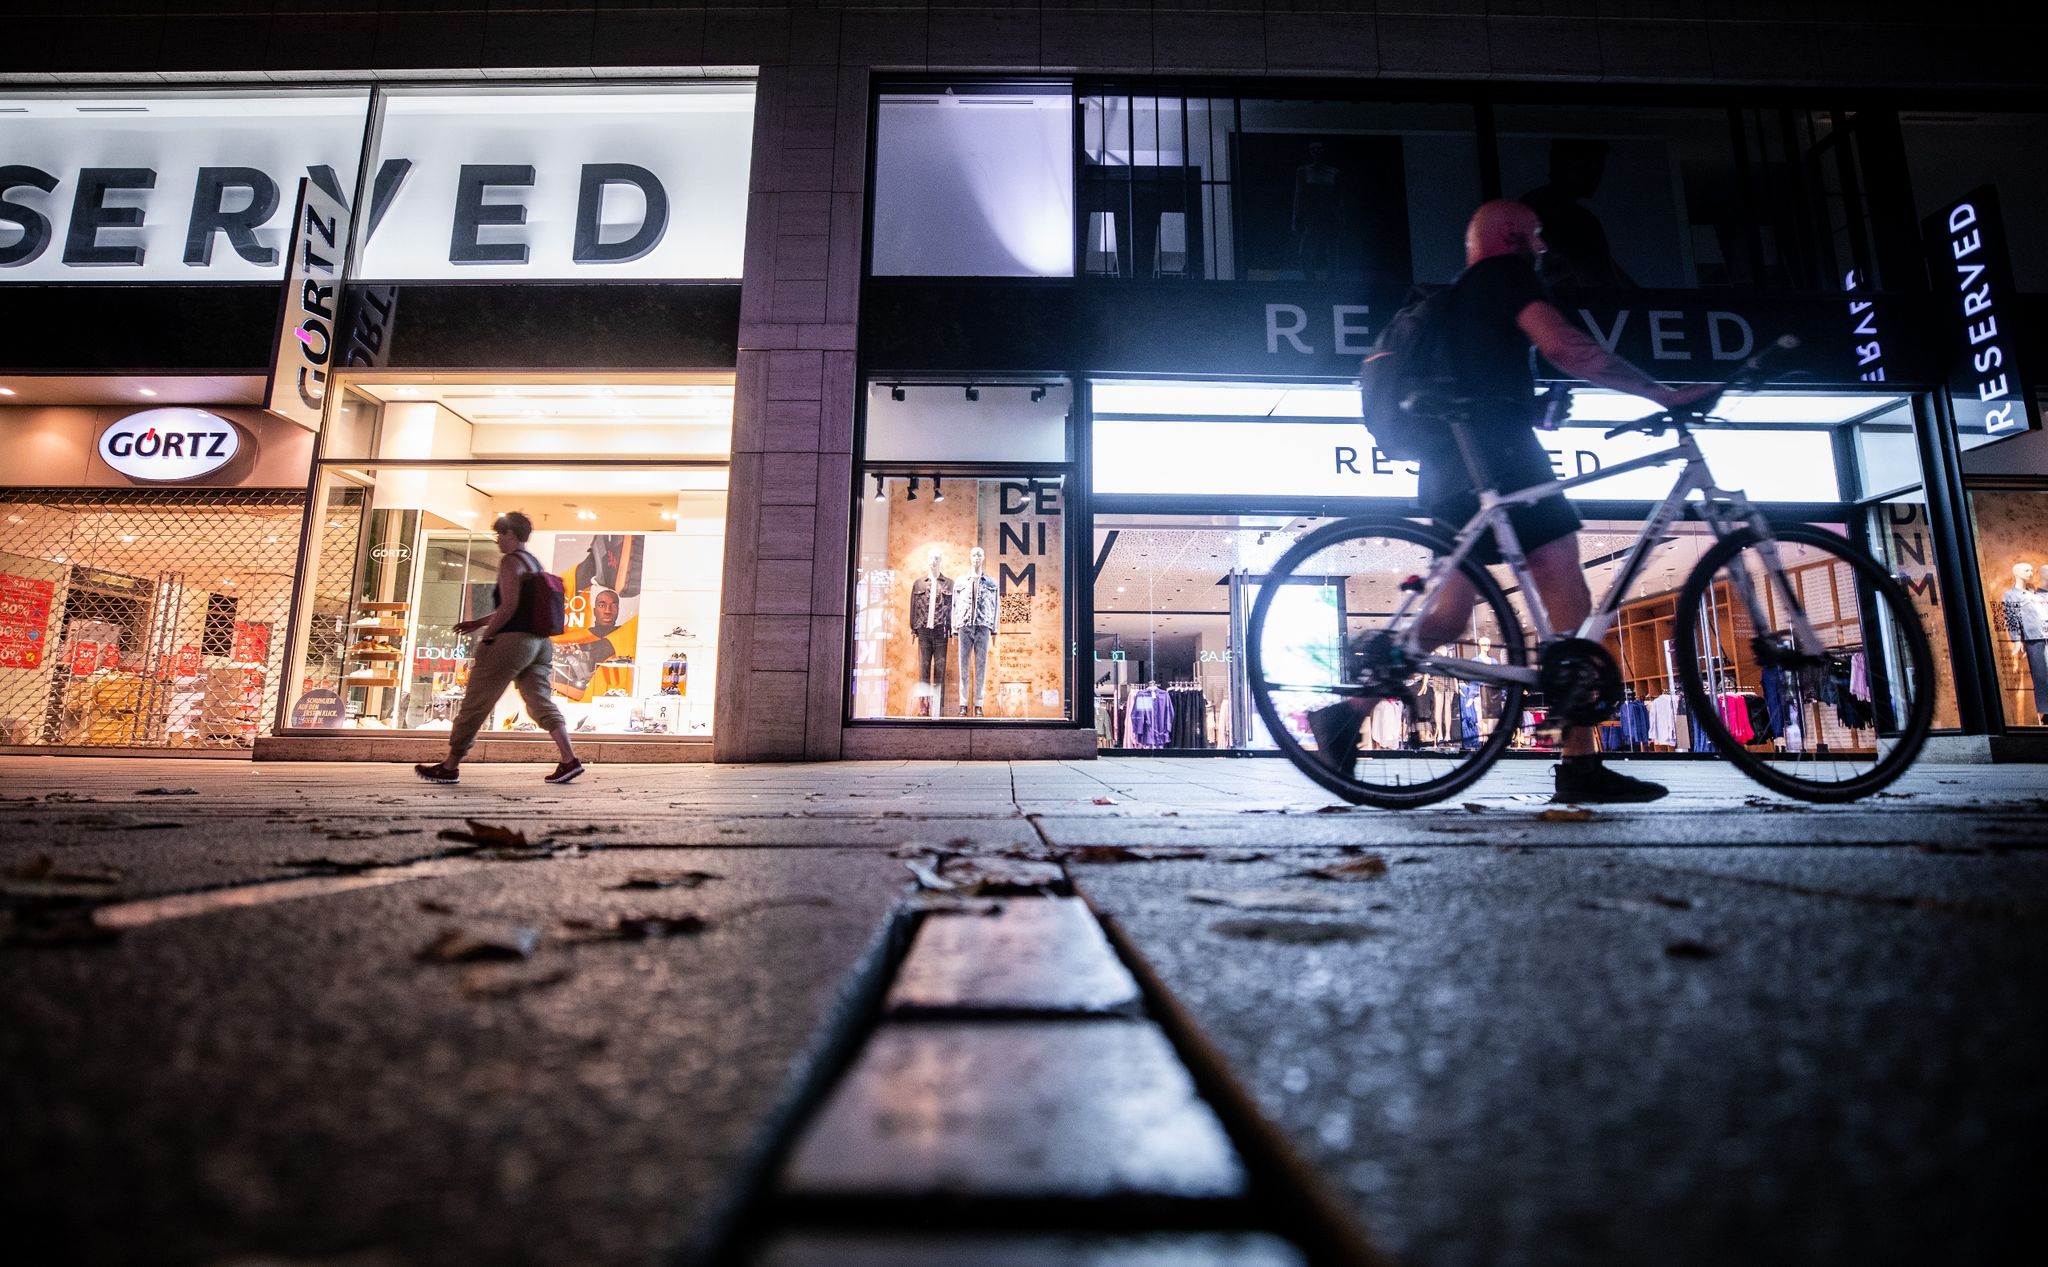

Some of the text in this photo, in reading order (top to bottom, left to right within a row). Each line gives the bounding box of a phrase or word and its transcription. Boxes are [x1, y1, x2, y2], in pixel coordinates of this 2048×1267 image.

[1265, 303, 1754, 361] REVED
[1949, 203, 2014, 434] RESERVED
[1335, 447, 1601, 480] REED
[1000, 482, 1061, 515] DE
[1000, 522, 1046, 556] NI
[1000, 563, 1036, 597] M
